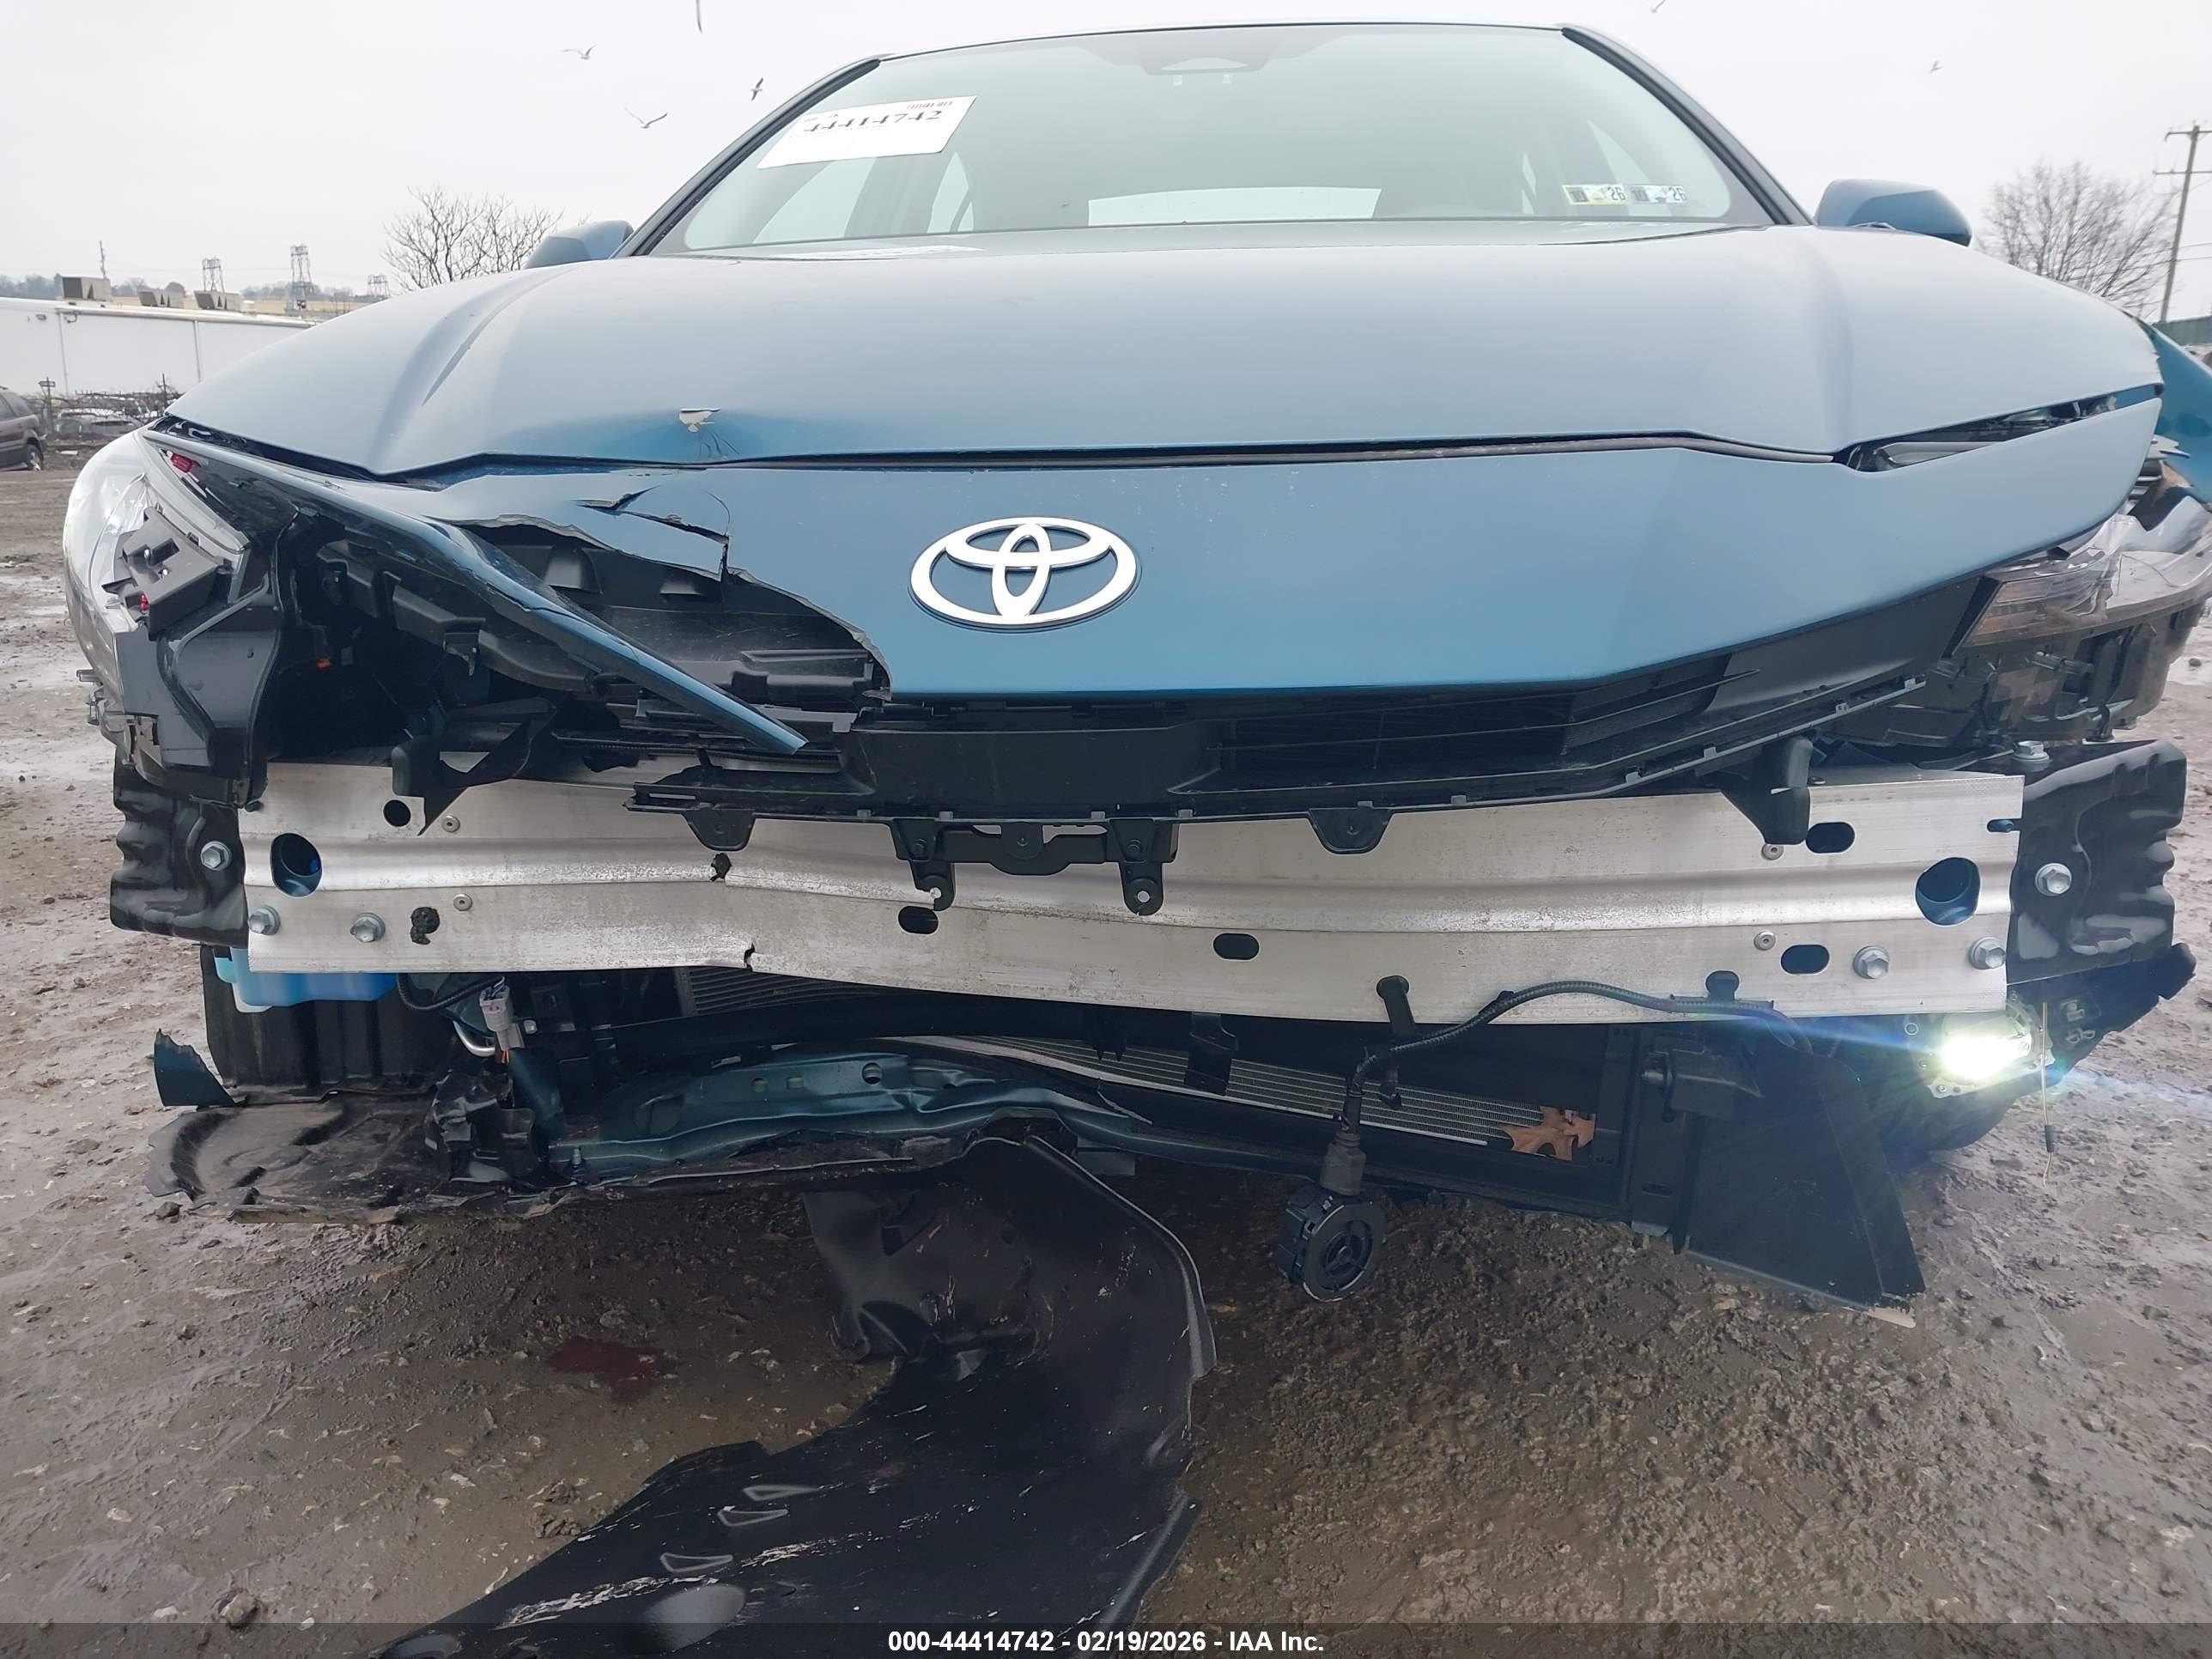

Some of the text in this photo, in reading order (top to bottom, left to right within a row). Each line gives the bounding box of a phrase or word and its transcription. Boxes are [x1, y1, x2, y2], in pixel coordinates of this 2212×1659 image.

[804, 110, 942, 132] 44414742
[1607, 186, 1626, 201] 26
[1669, 186, 1687, 201] 26
